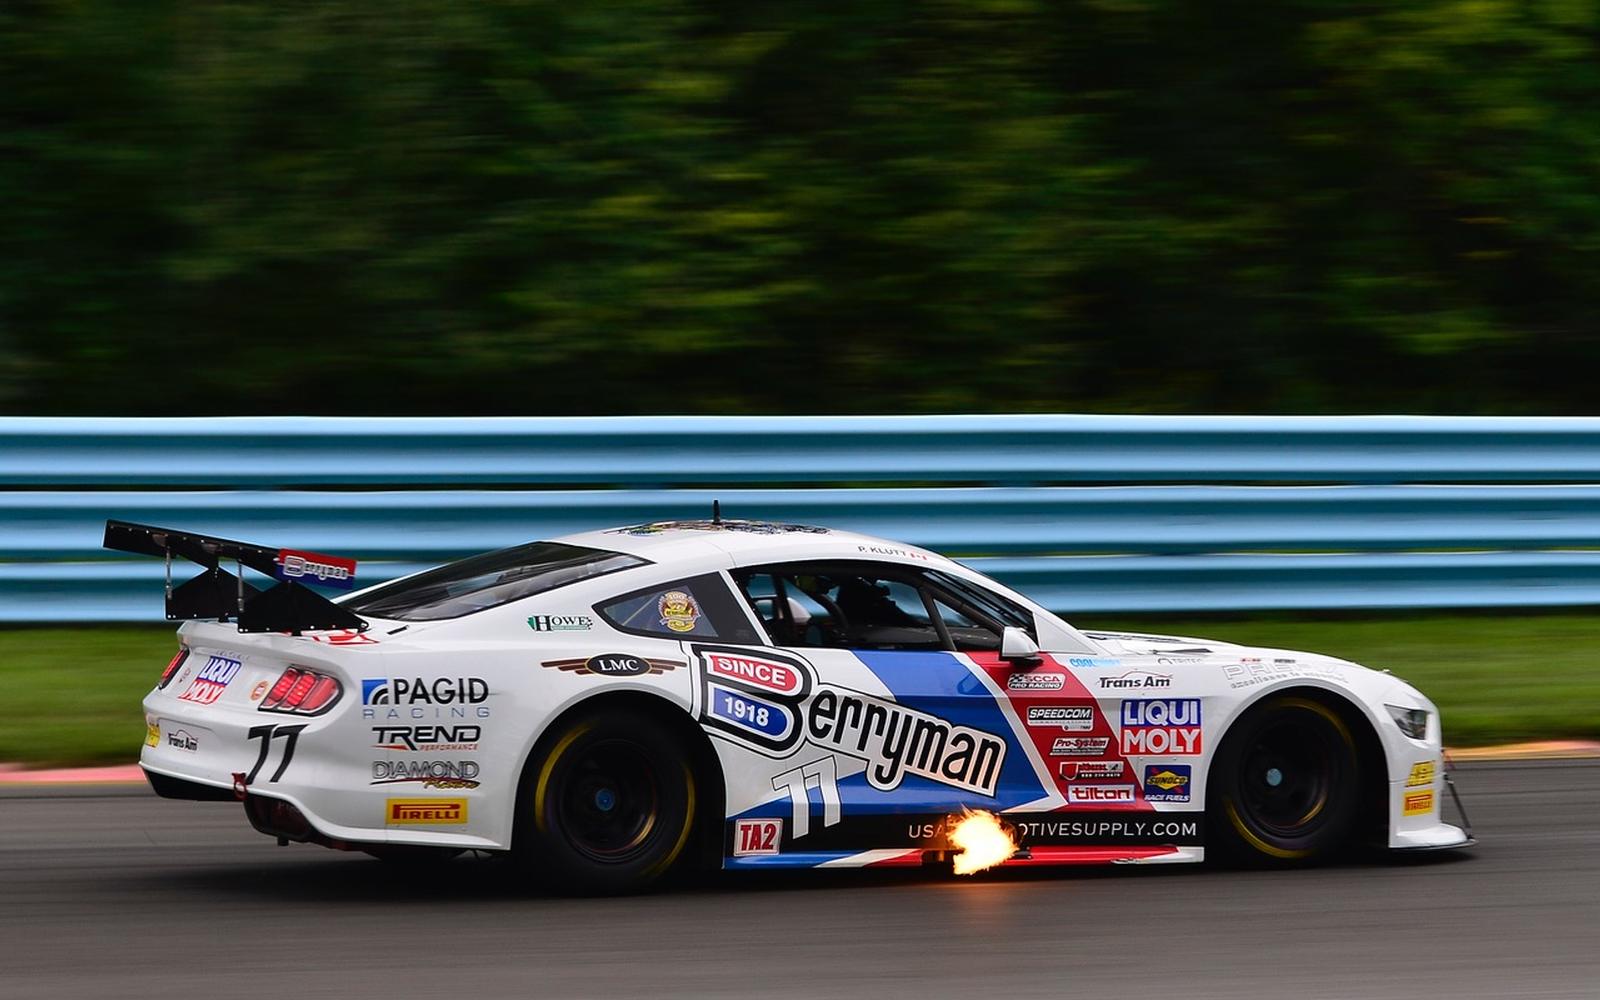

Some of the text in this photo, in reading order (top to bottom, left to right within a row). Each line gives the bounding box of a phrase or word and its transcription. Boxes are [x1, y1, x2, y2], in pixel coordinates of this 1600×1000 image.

[534, 615, 588, 631] HOWE
[200, 658, 239, 684] LIQUI
[599, 656, 639, 672] LMC
[718, 655, 786, 687] SINCE
[183, 681, 225, 702] MOLY
[393, 678, 488, 704] PAGID
[1100, 676, 1170, 688] Trans Am
[363, 706, 490, 719] RACING
[692, 643, 1004, 793] Berryman
[724, 695, 770, 727] 1918
[1029, 709, 1091, 718] SPEEDCOM
[1123, 702, 1198, 725] LIQUI
[168, 733, 184, 748] Trans
[185, 737, 197, 751] Am
[372, 725, 481, 750] TREND
[1123, 729, 1200, 753] MOLY
[246, 723, 308, 785] 77
[371, 760, 480, 779] DIAMOND
[1150, 776, 1185, 784] SUNOCO
[772, 755, 841, 839] 77
[1072, 788, 1130, 800] tilton
[392, 804, 460, 820] PIRELLI
[741, 824, 774, 851] TA2
